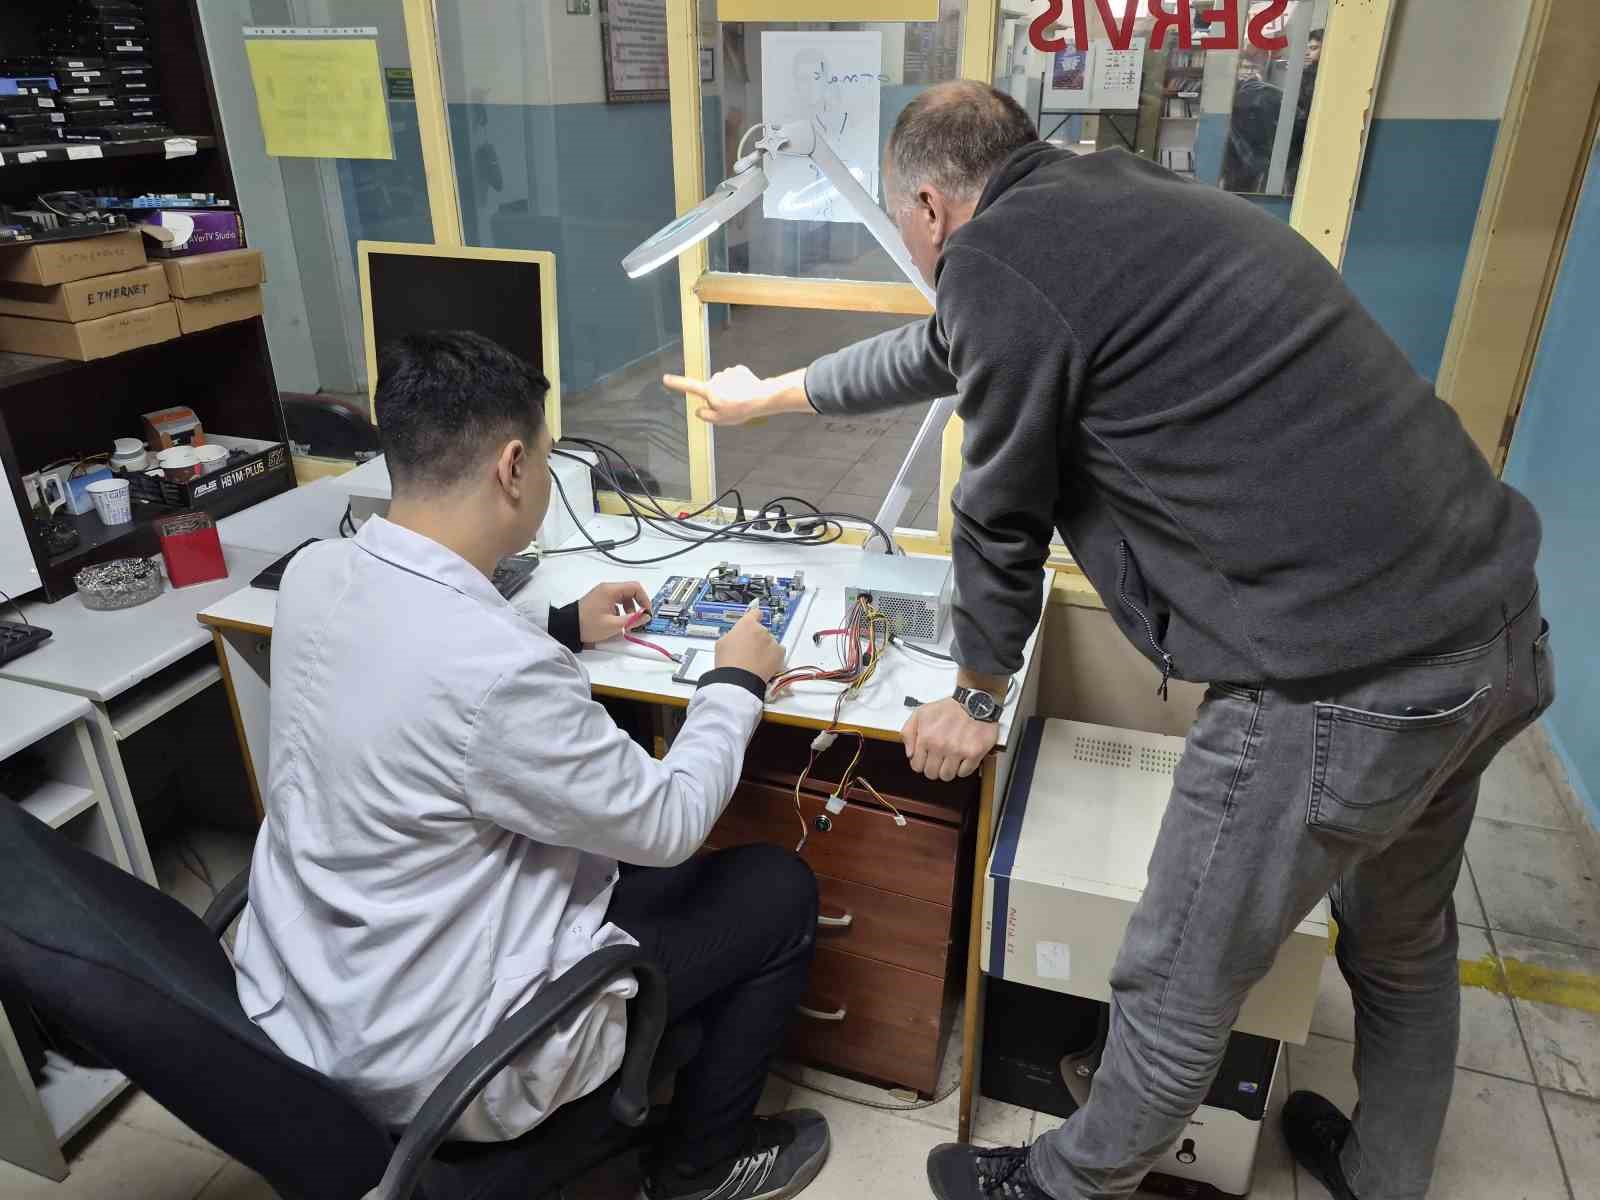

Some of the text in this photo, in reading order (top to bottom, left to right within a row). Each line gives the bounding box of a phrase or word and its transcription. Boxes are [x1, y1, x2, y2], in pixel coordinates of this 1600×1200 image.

[87, 284, 149, 306] ETHERNET
[194, 462, 265, 498] ASUS H81M-PLUS
